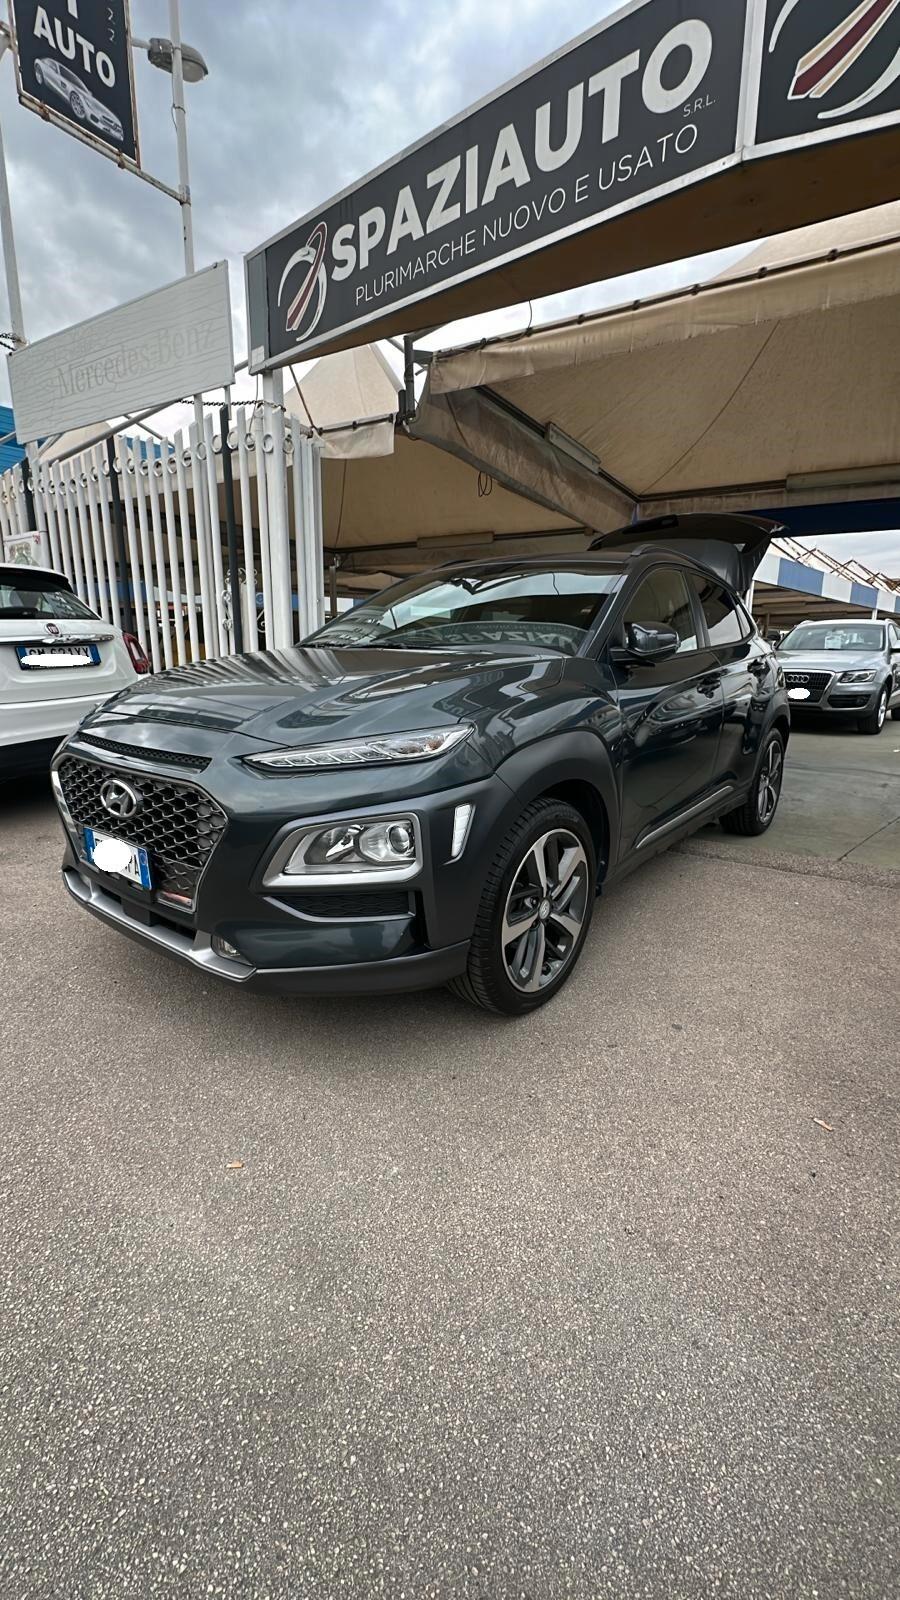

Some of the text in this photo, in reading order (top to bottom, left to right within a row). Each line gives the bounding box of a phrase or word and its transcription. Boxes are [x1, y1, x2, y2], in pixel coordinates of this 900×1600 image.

[33, 5, 116, 88] AUTO
[683, 94, 716, 118] S.R.L.
[331, 19, 713, 282] SPAZIAUTO
[355, 123, 698, 307] PLURIMARCHE NUOVO E USATO
